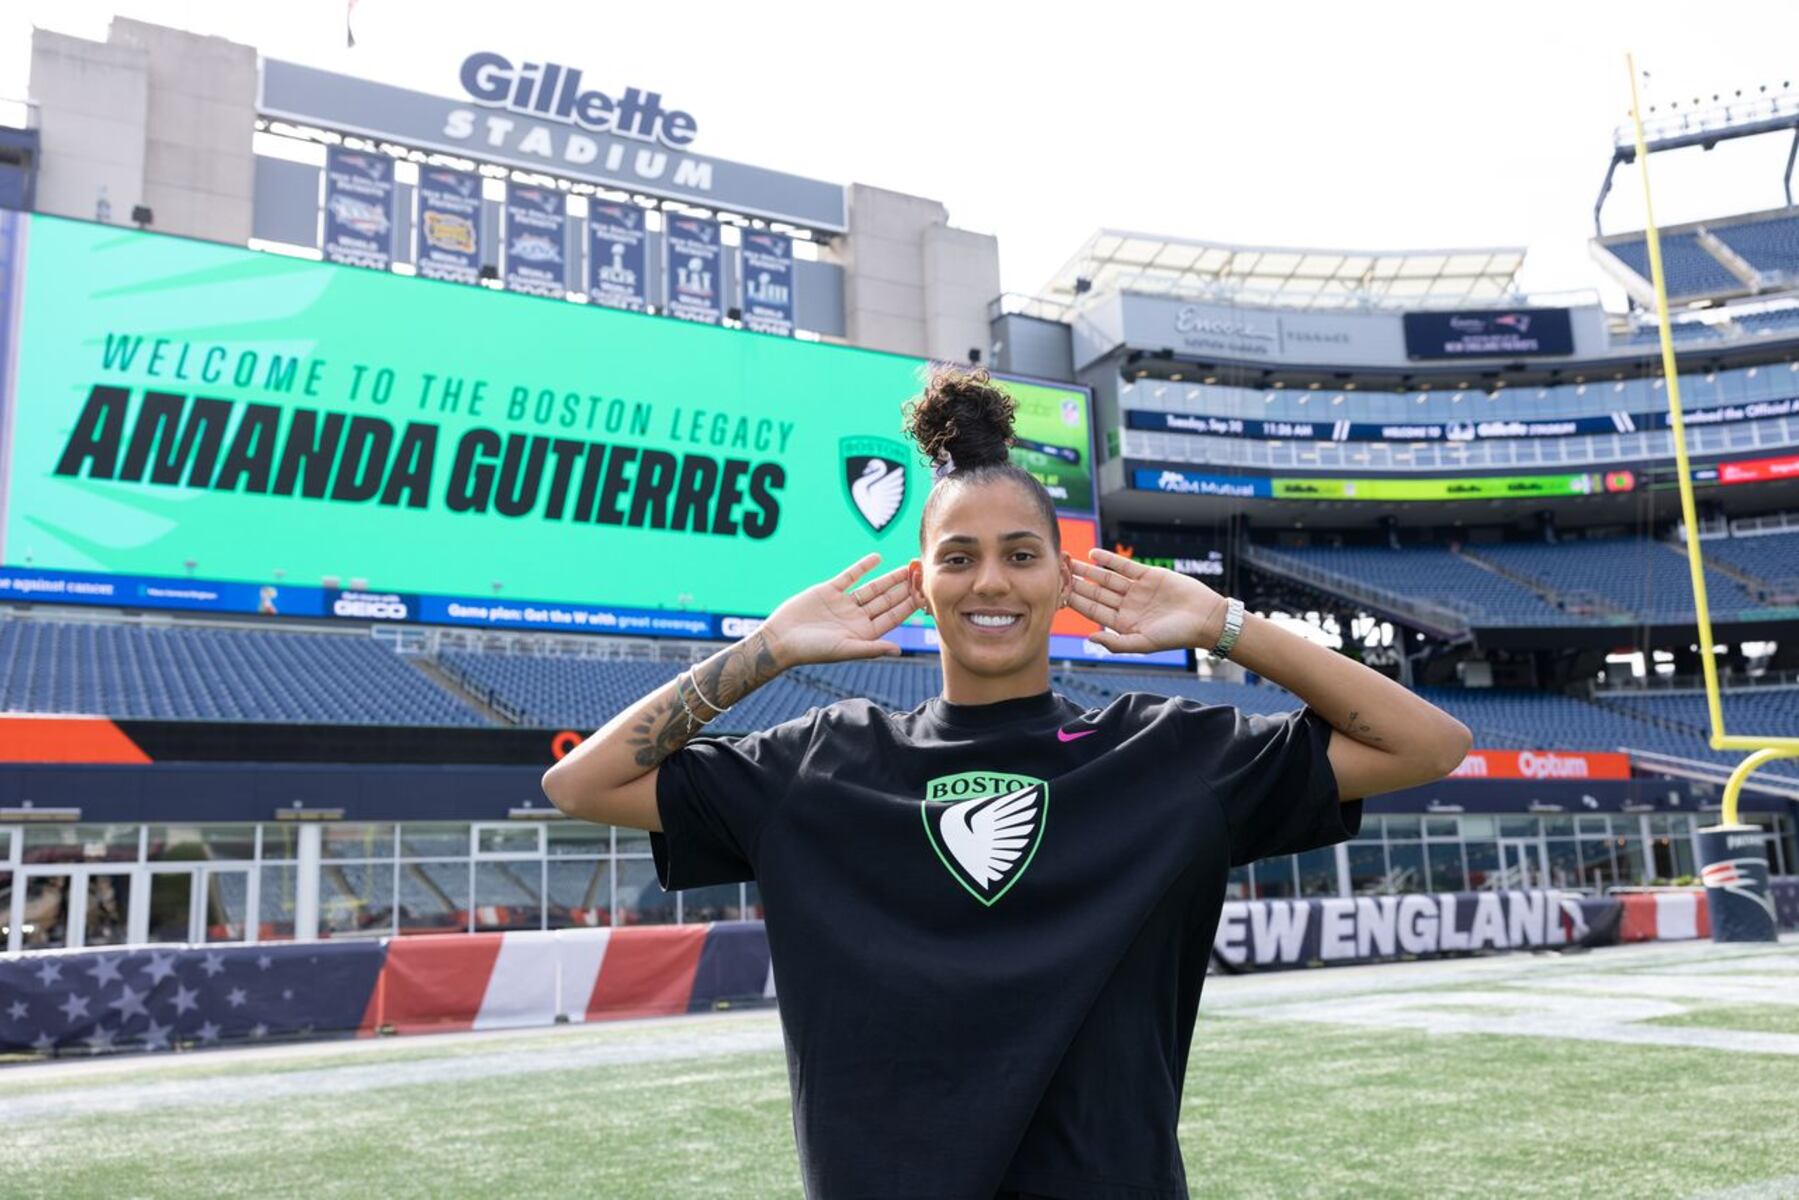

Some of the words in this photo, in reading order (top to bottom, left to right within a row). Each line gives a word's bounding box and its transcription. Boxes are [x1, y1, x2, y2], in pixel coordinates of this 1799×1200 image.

[459, 50, 699, 147] Gillette
[443, 108, 713, 190] STADIUM
[102, 332, 327, 397] WELCOME
[349, 364, 396, 405] TO
[418, 374, 488, 417] THE
[507, 386, 652, 436] BOSTON
[670, 407, 794, 453] LEGACY
[1724, 406, 1745, 420] the
[1745, 401, 1791, 418] Official
[52, 383, 440, 510] AMANDA
[445, 426, 787, 540] GUTIERRES
[1200, 480, 1255, 497] Mutual
[12, 576, 65, 592] against
[333, 600, 407, 619] GEICO
[448, 602, 488, 619] Game
[523, 607, 548, 622] Get
[549, 609, 572, 623] the
[618, 615, 649, 629] great
[1518, 751, 1589, 780] Optum
[932, 777, 1035, 799] BOSTO
[1213, 899, 1311, 963] EW
